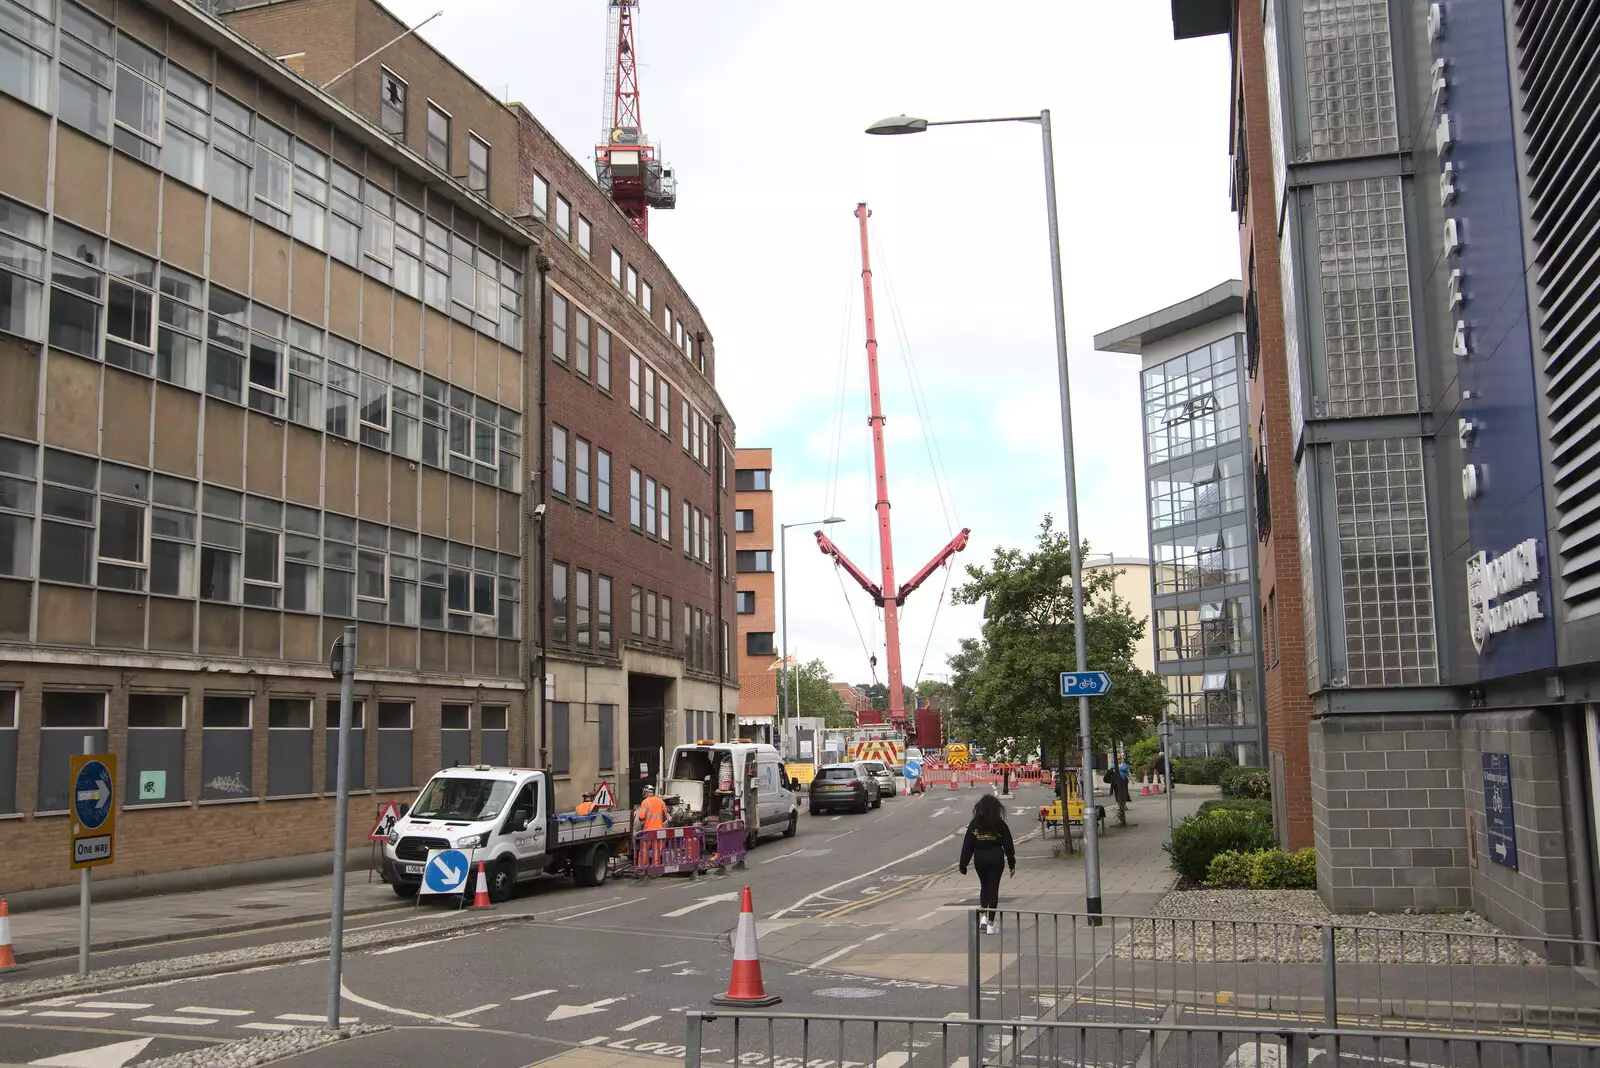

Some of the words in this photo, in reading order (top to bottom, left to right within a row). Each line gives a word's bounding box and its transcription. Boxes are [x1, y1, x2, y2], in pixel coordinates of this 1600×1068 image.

[1427, 3, 1468, 356] ANDREWS
[1064, 675, 1077, 693] P
[406, 824, 442, 832] Claret
[77, 843, 92, 855] One
[94, 842, 109, 853] way
[607, 1038, 721, 1058] LOOK
